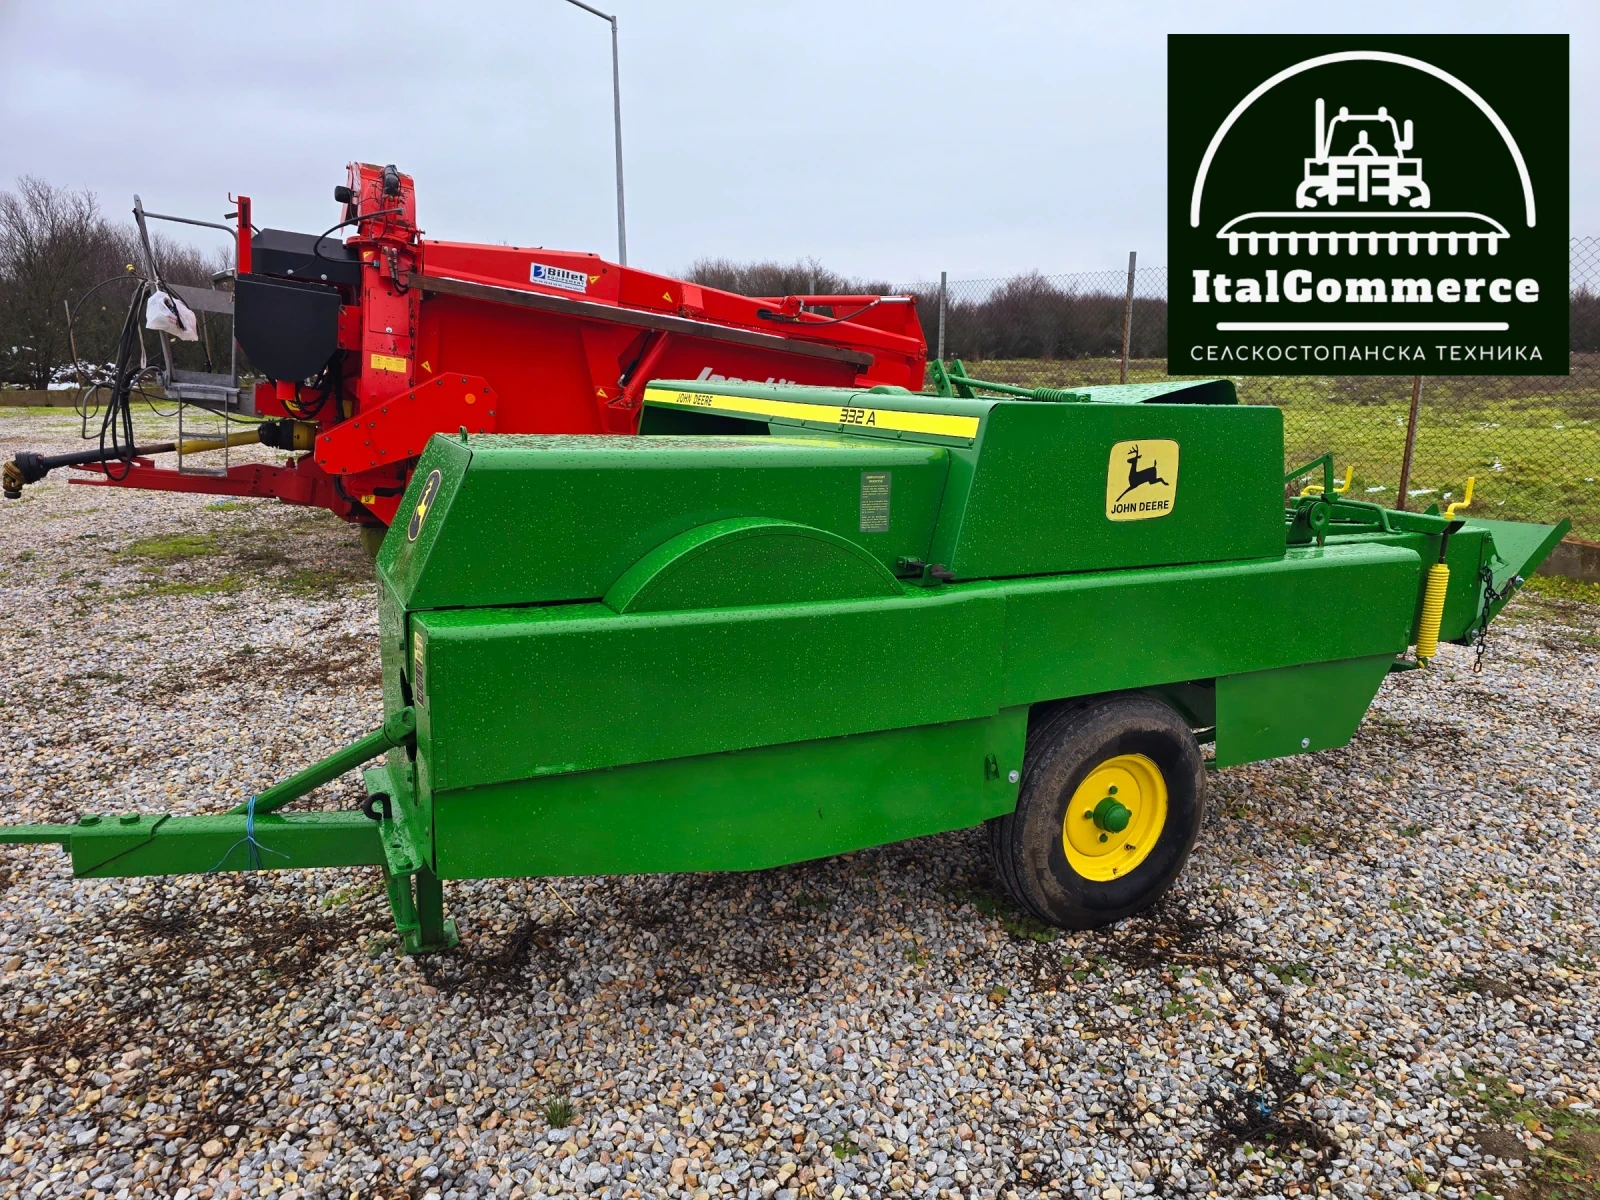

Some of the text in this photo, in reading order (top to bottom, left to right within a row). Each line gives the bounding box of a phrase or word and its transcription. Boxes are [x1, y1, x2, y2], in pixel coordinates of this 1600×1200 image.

[548, 268, 584, 282] Billet
[676, 393, 713, 407] JOHN DEERE
[840, 408, 876, 426] 332 A
[1111, 500, 1169, 514] JOHN DEERE
